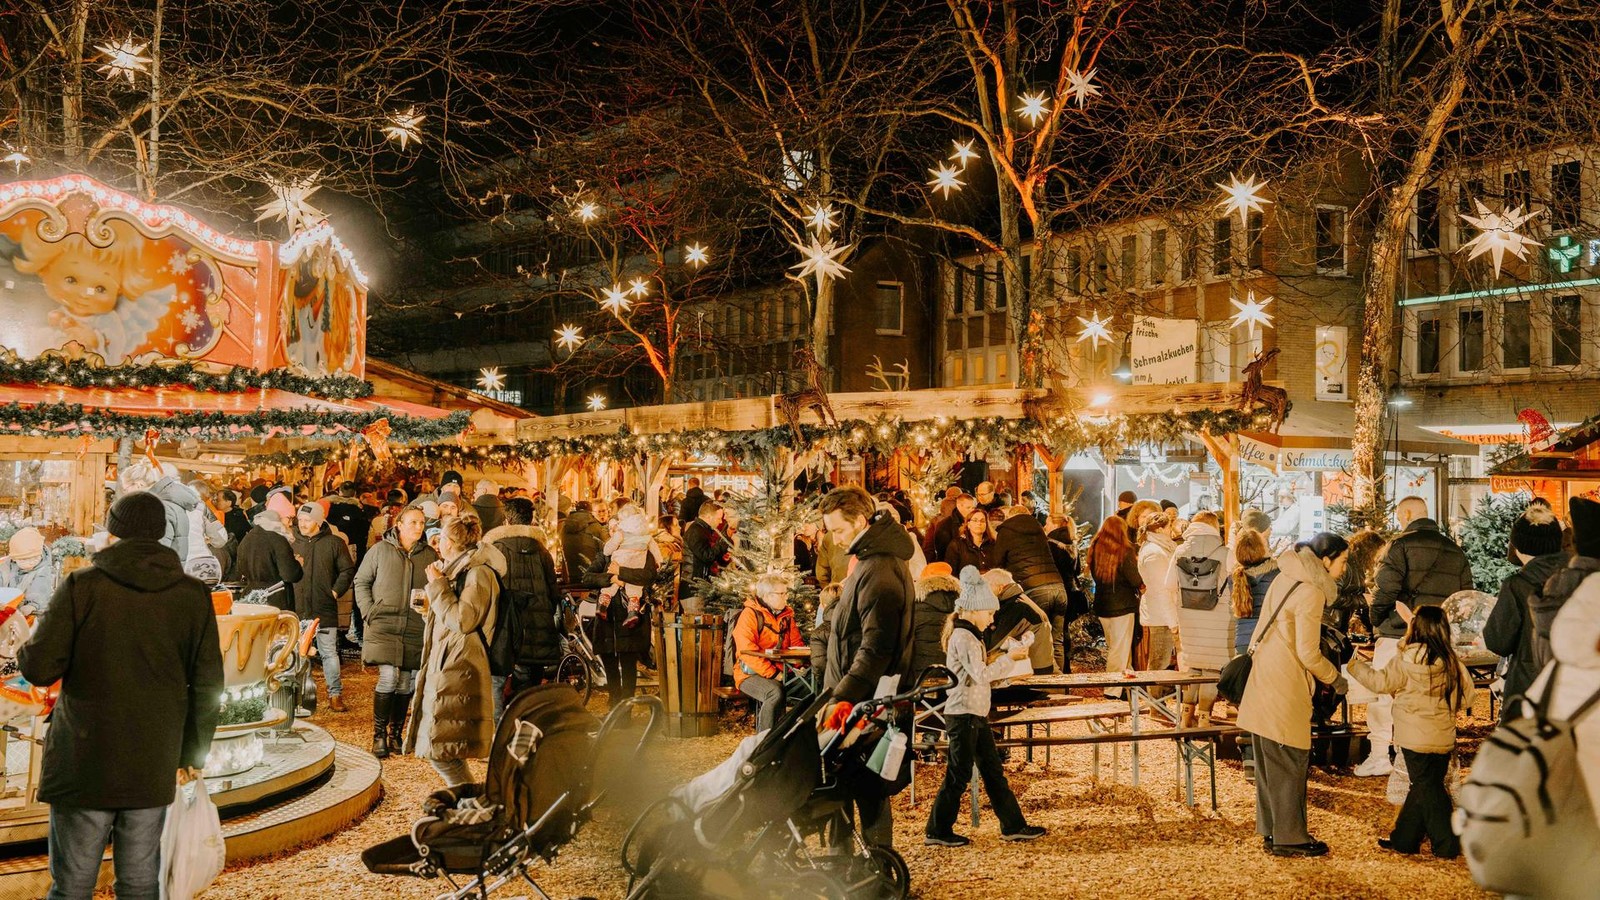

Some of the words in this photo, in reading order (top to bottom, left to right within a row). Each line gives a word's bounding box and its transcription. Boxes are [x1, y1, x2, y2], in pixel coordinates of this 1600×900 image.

[1136, 327, 1158, 338] frische
[1134, 344, 1194, 368] Schmalzkuchen
[1239, 442, 1265, 461] affee
[1285, 452, 1350, 467] Schmalzku
